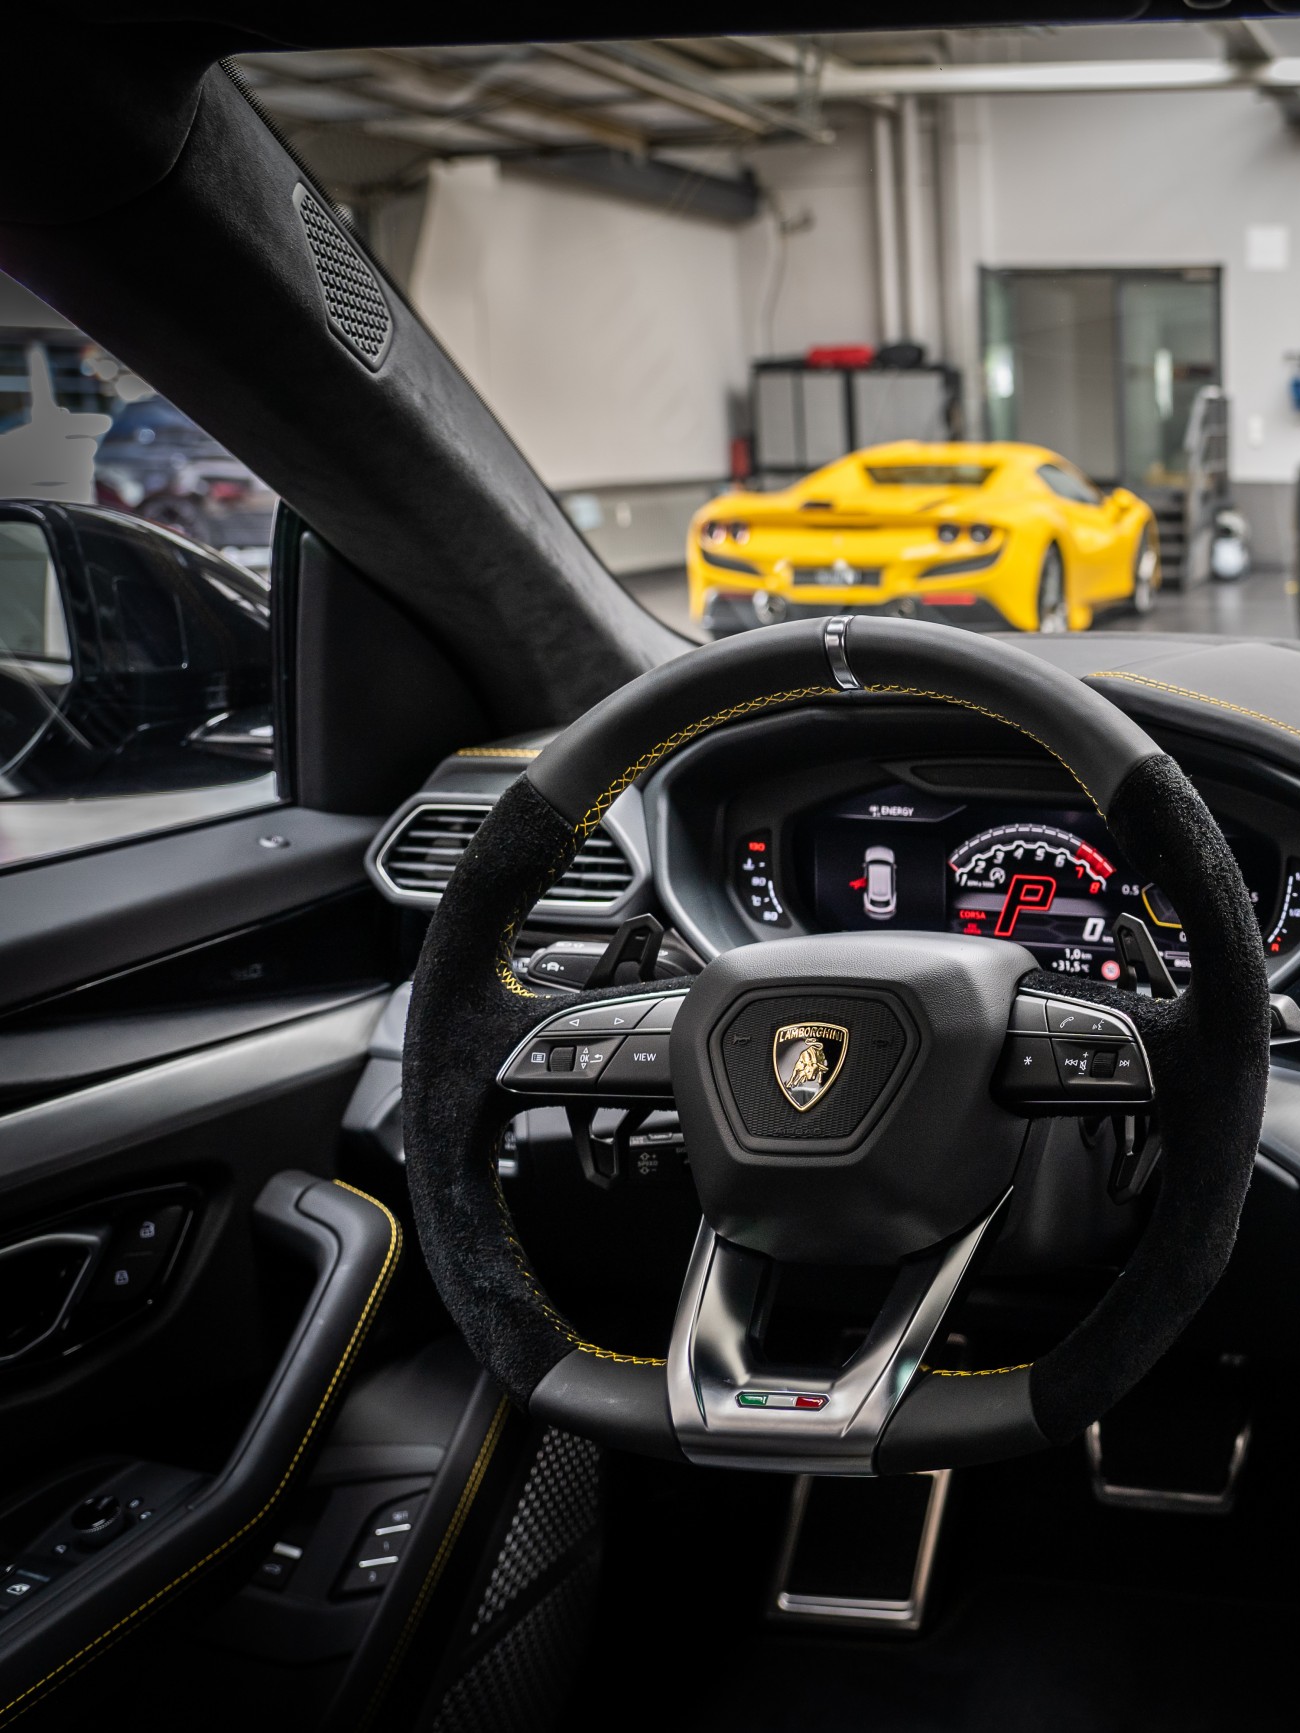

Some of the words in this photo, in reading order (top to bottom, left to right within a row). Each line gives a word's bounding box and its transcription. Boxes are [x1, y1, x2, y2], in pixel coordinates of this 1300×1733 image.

[881, 806, 914, 817] ENERGY
[974, 860, 986, 873] 2
[993, 851, 1005, 865] 3
[1013, 847, 1024, 861] 4
[1035, 849, 1046, 861] 5
[1054, 854, 1066, 867] 6
[1075, 867, 1084, 879] 7
[1089, 881, 1101, 894] 8
[1121, 884, 1140, 896] 0.5
[994, 874, 1057, 937] P
[960, 909, 986, 920] CORSA
[1082, 917, 1105, 942] 0
[779, 1026, 843, 1042] LAMBORGHINI
[580, 1054, 589, 1063] OK
[633, 1053, 657, 1062] VIEW
